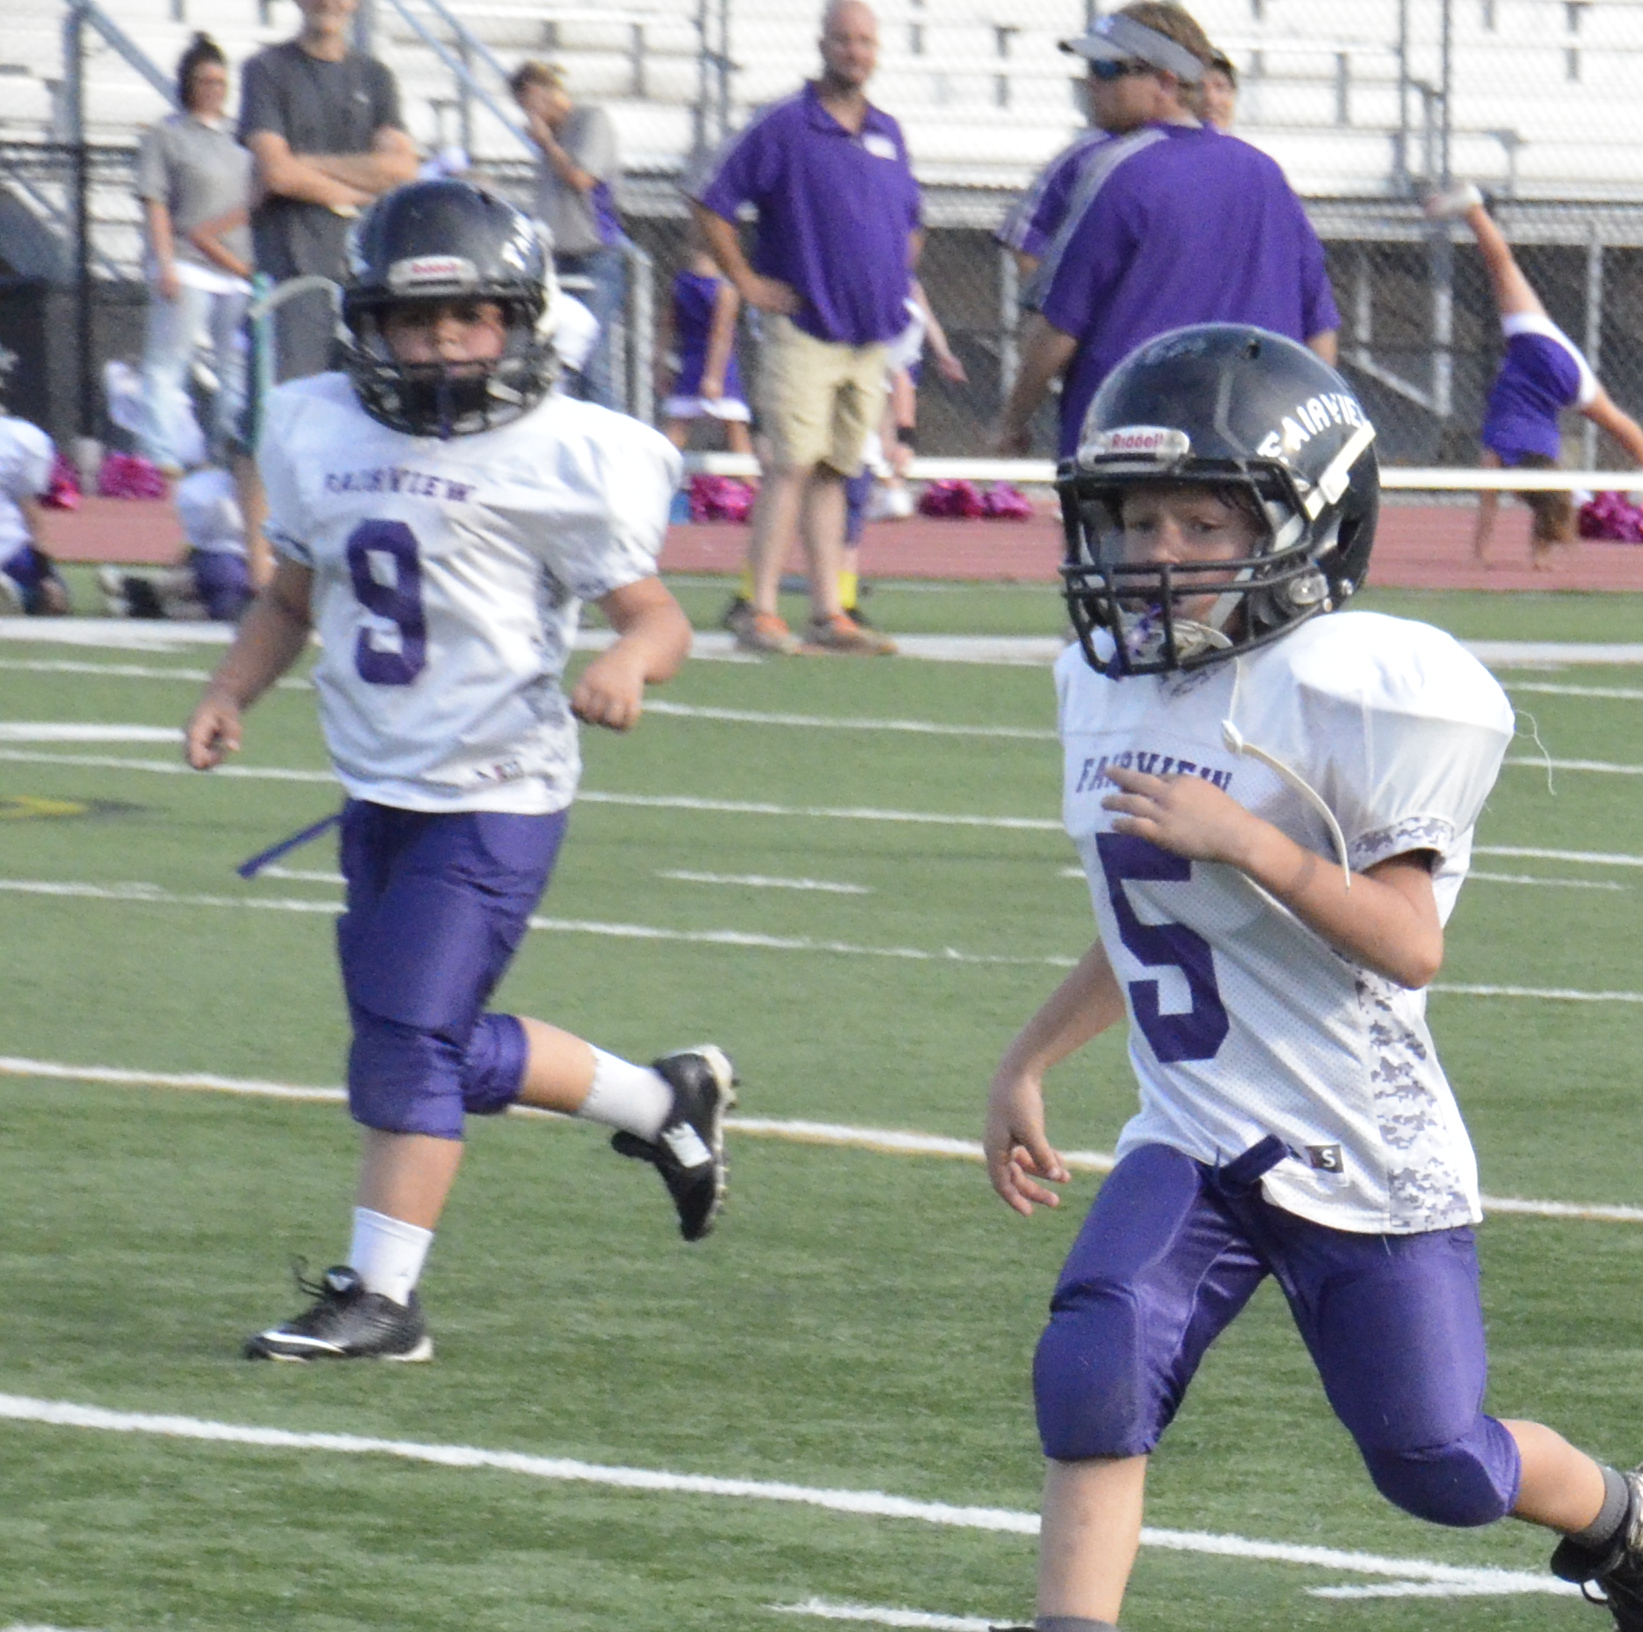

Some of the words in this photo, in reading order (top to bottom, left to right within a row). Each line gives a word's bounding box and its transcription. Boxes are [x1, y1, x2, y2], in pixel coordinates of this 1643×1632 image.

[1111, 432, 1165, 449] Riddell
[1256, 392, 1366, 466] FAIRVIE
[346, 518, 427, 687] 9
[1095, 832, 1229, 1063] 5
[1321, 1148, 1337, 1169] S
